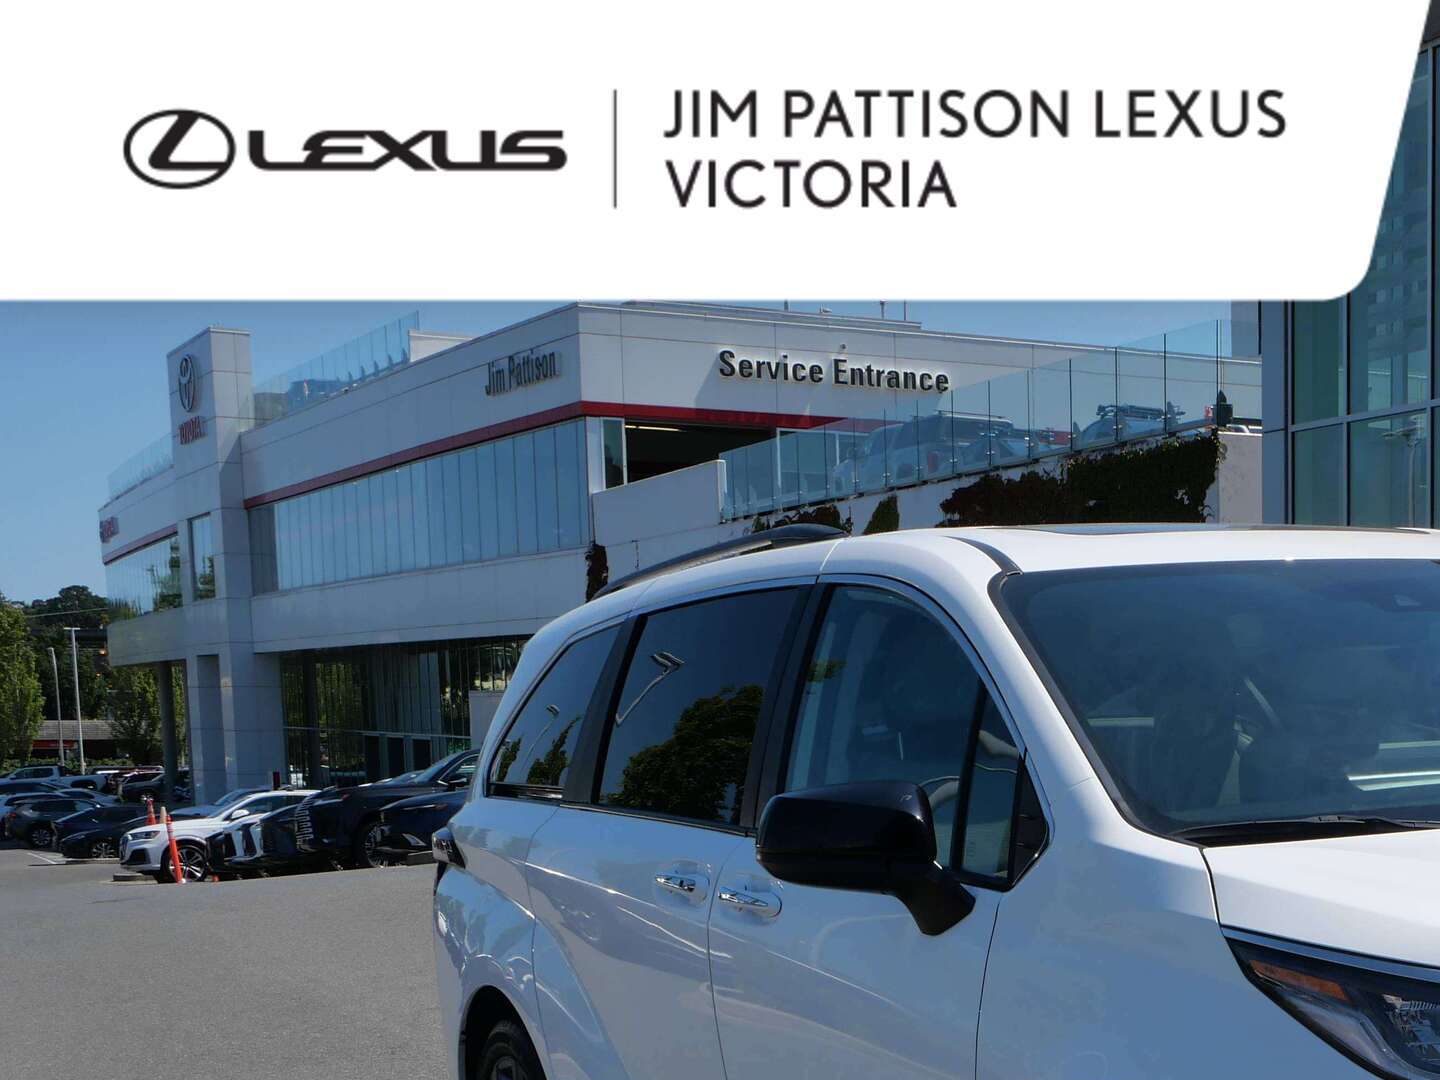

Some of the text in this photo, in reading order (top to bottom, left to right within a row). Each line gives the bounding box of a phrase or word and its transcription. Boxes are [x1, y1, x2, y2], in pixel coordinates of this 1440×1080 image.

[485, 348, 557, 396] Jim Pattison
[718, 349, 950, 394] Service Entrance
